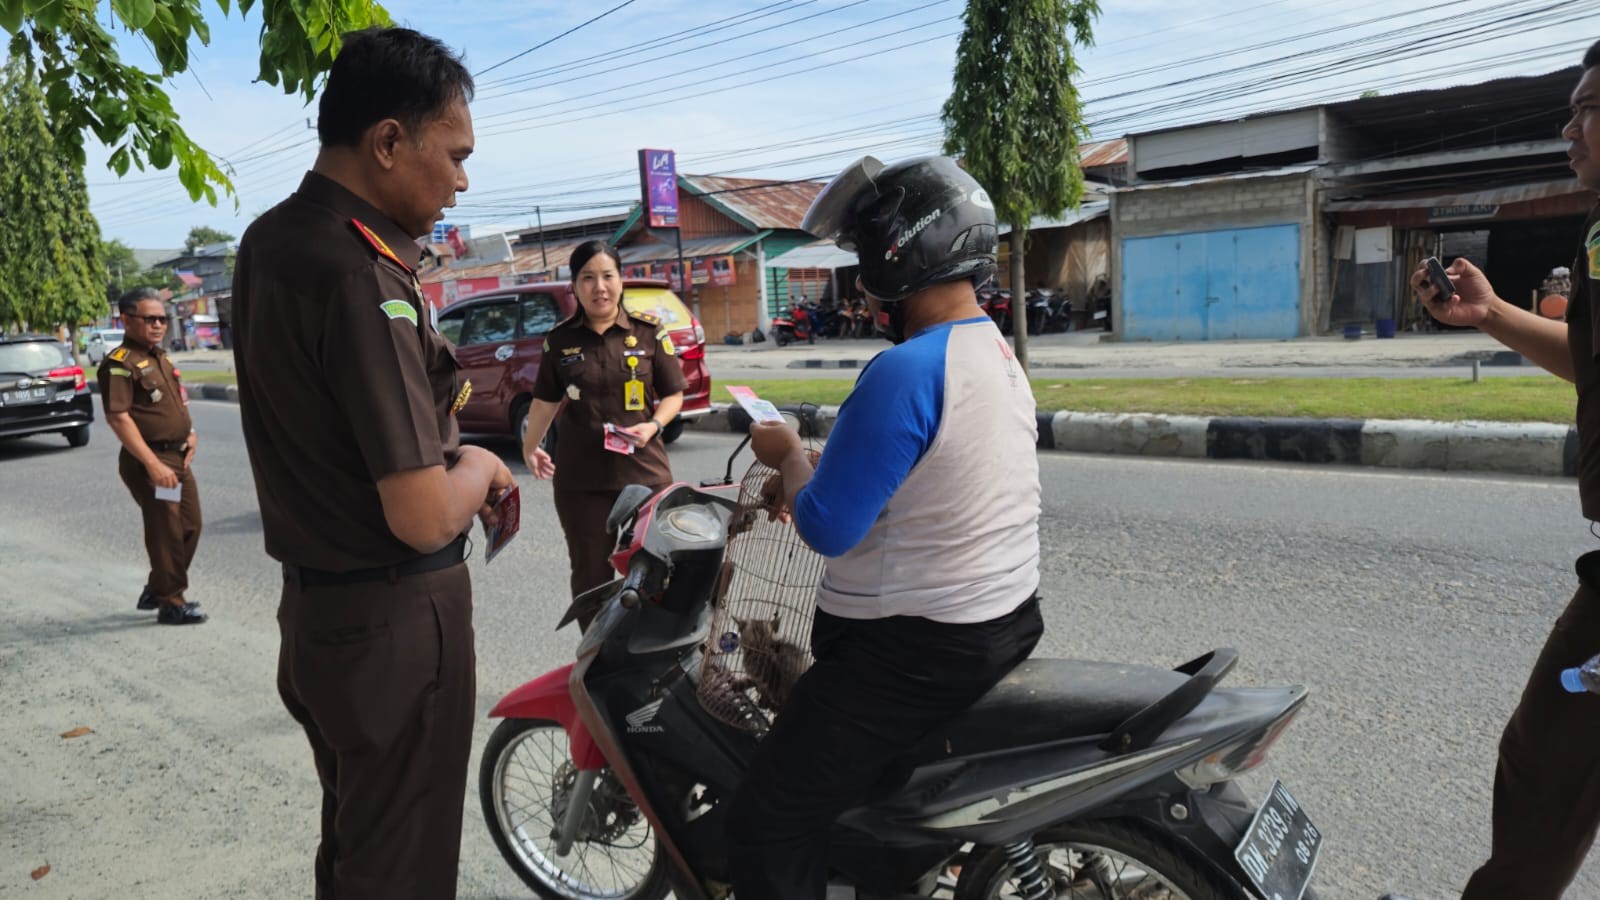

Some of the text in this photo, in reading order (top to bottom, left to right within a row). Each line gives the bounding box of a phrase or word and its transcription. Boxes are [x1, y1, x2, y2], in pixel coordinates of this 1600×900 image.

[627, 726, 664, 734] HONDA
[1243, 843, 1269, 883] DN
[1258, 807, 1289, 855] 3239
